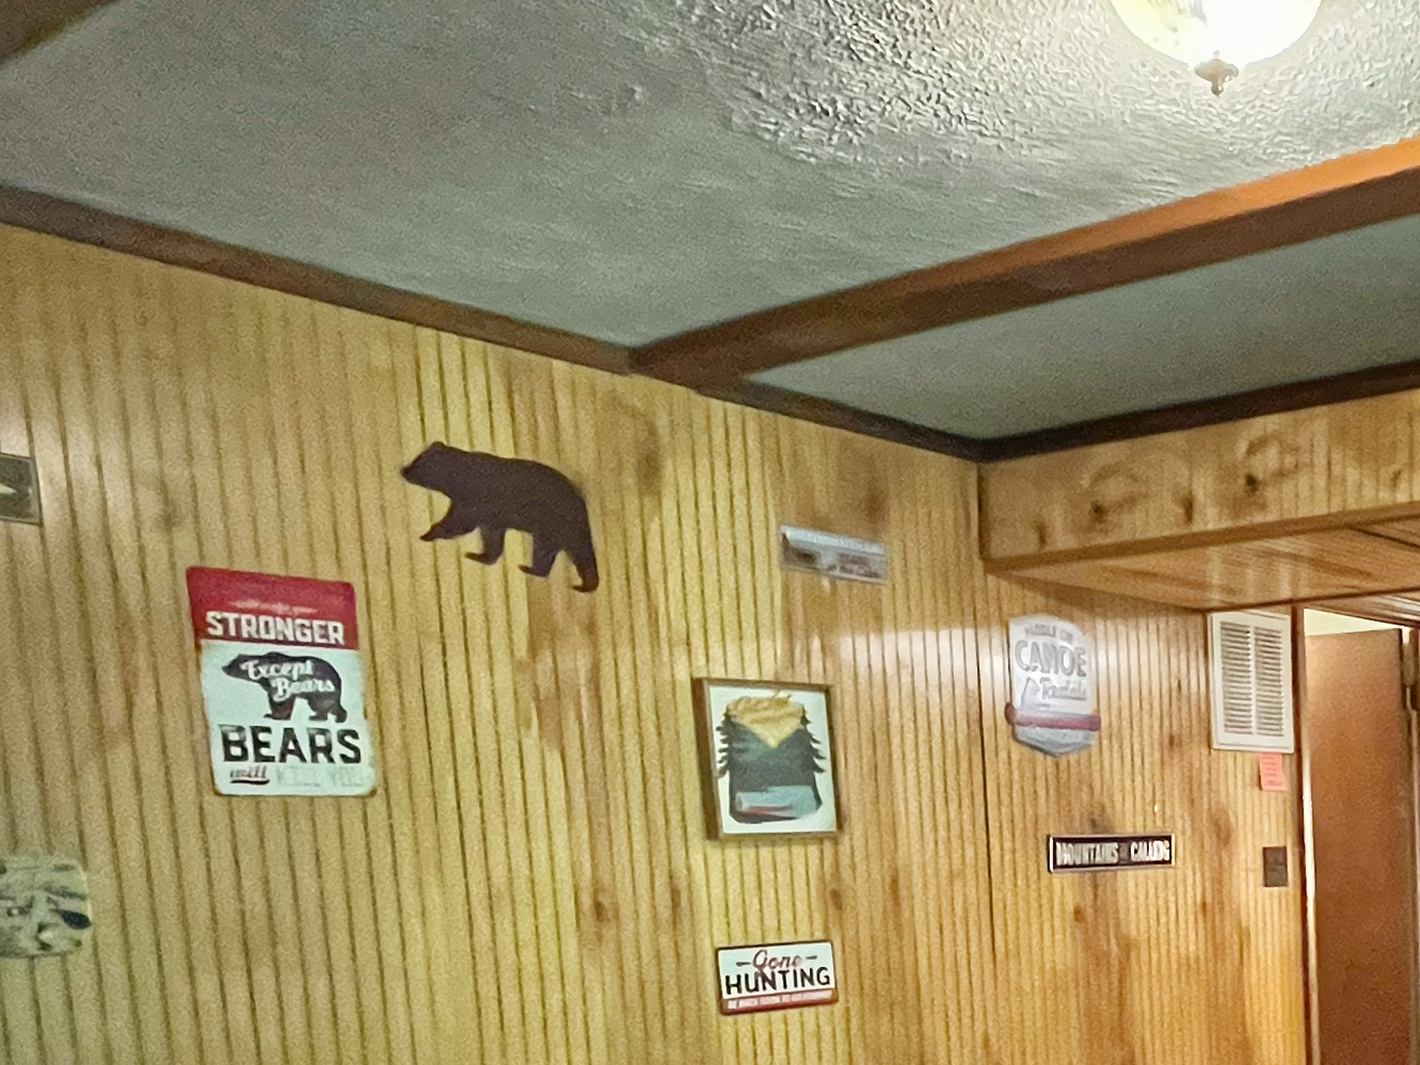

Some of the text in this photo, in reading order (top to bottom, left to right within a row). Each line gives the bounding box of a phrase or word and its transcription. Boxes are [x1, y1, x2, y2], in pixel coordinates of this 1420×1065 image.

[205, 610, 345, 645] STRONGER
[241, 658, 315, 682] Except
[1015, 639, 1087, 677] CANOE
[270, 677, 335, 702] Bears
[218, 723, 362, 764] BEARS
[725, 967, 831, 995] HUNTING
